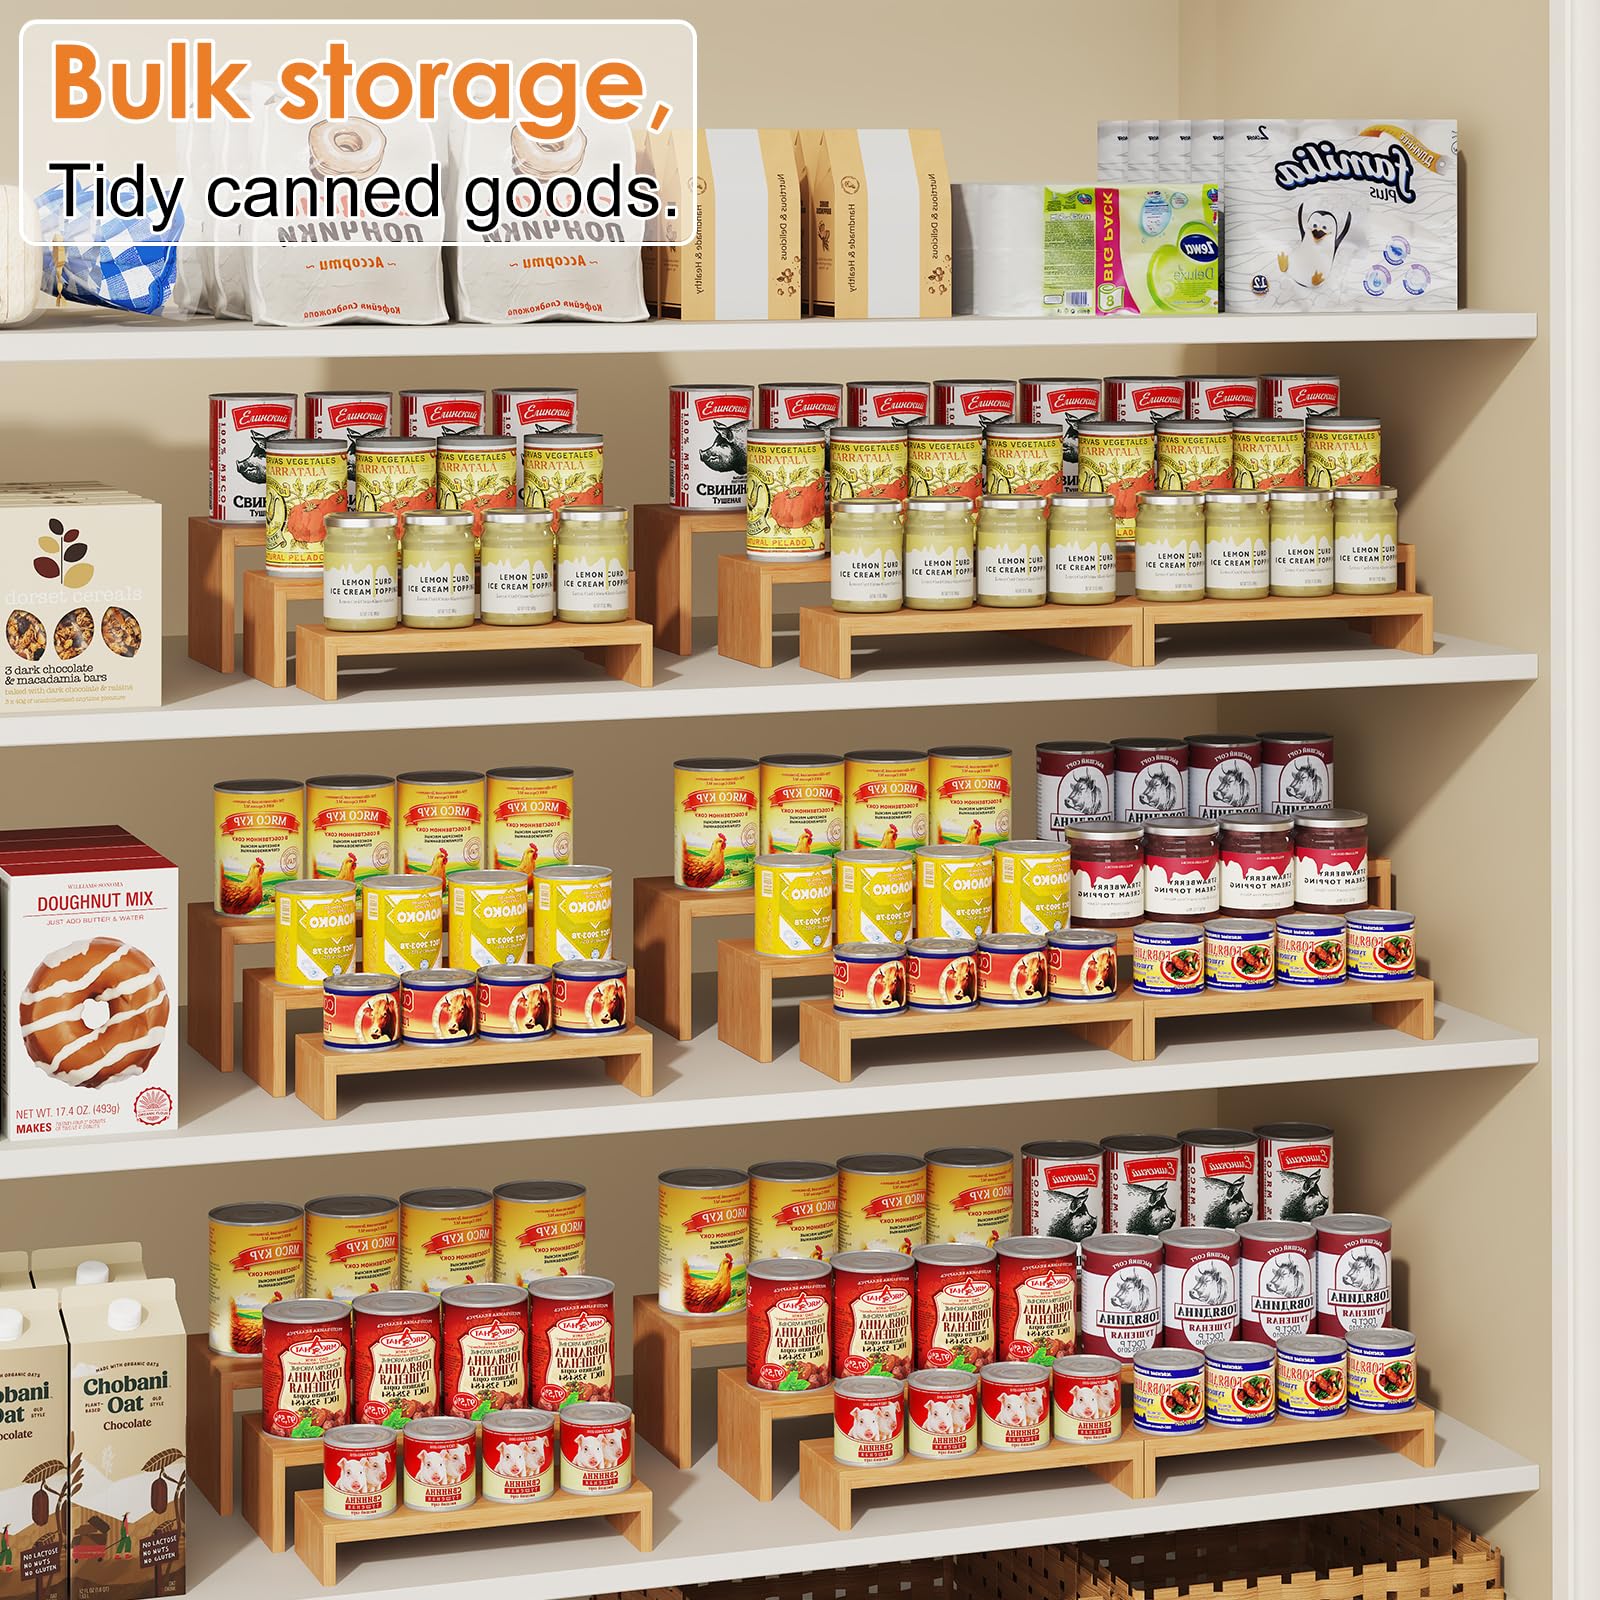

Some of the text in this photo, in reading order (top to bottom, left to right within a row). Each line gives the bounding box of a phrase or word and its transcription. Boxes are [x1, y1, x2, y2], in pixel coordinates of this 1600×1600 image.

[1332, 432, 1375, 442] VEGETALES
[770, 445, 817, 455] VEGETALES
[286, 455, 336, 466] VEGETALES
[1288, 548, 1315, 556] LEMON
[998, 556, 1025, 565] LEMON
[1275, 556, 1315, 565] ICE CREAM
[576, 570, 604, 579] LEMON
[985, 564, 1026, 574] ICE CREAM
[342, 577, 371, 586] LEMON
[564, 578, 605, 589] ICE CREAM
[330, 586, 372, 596] ICE CREAM
[5, 663, 94, 676] 3 dark chocolate
[4, 673, 107, 685] & macadamia bars
[28, 686, 45, 695] with
[46, 685, 64, 694] dark
[38, 890, 153, 912] DOUGHNUT MIX
[47, 918, 64, 926] JUST
[82, 915, 111, 924] BUTTER
[119, 914, 144, 922] WATER
[15, 1103, 120, 1120] NET WT. 17.4 OZ. (493g)
[16, 1122, 52, 1134] MAKES
[83, 1370, 169, 1396] Chobani
[107, 1395, 144, 1414] Oat
[0, 1406, 25, 1424] at
[103, 1418, 152, 1431] Chocolate
[152, 1534, 177, 1547] LACTOSE
[23, 1546, 59, 1562] NO LACTOSE
[152, 1546, 170, 1555] NUTS
[23, 1558, 51, 1570] NO NUTS
[143, 1552, 177, 1566] NO GLUTEN
[35, 1564, 58, 1575] GLUTEN
